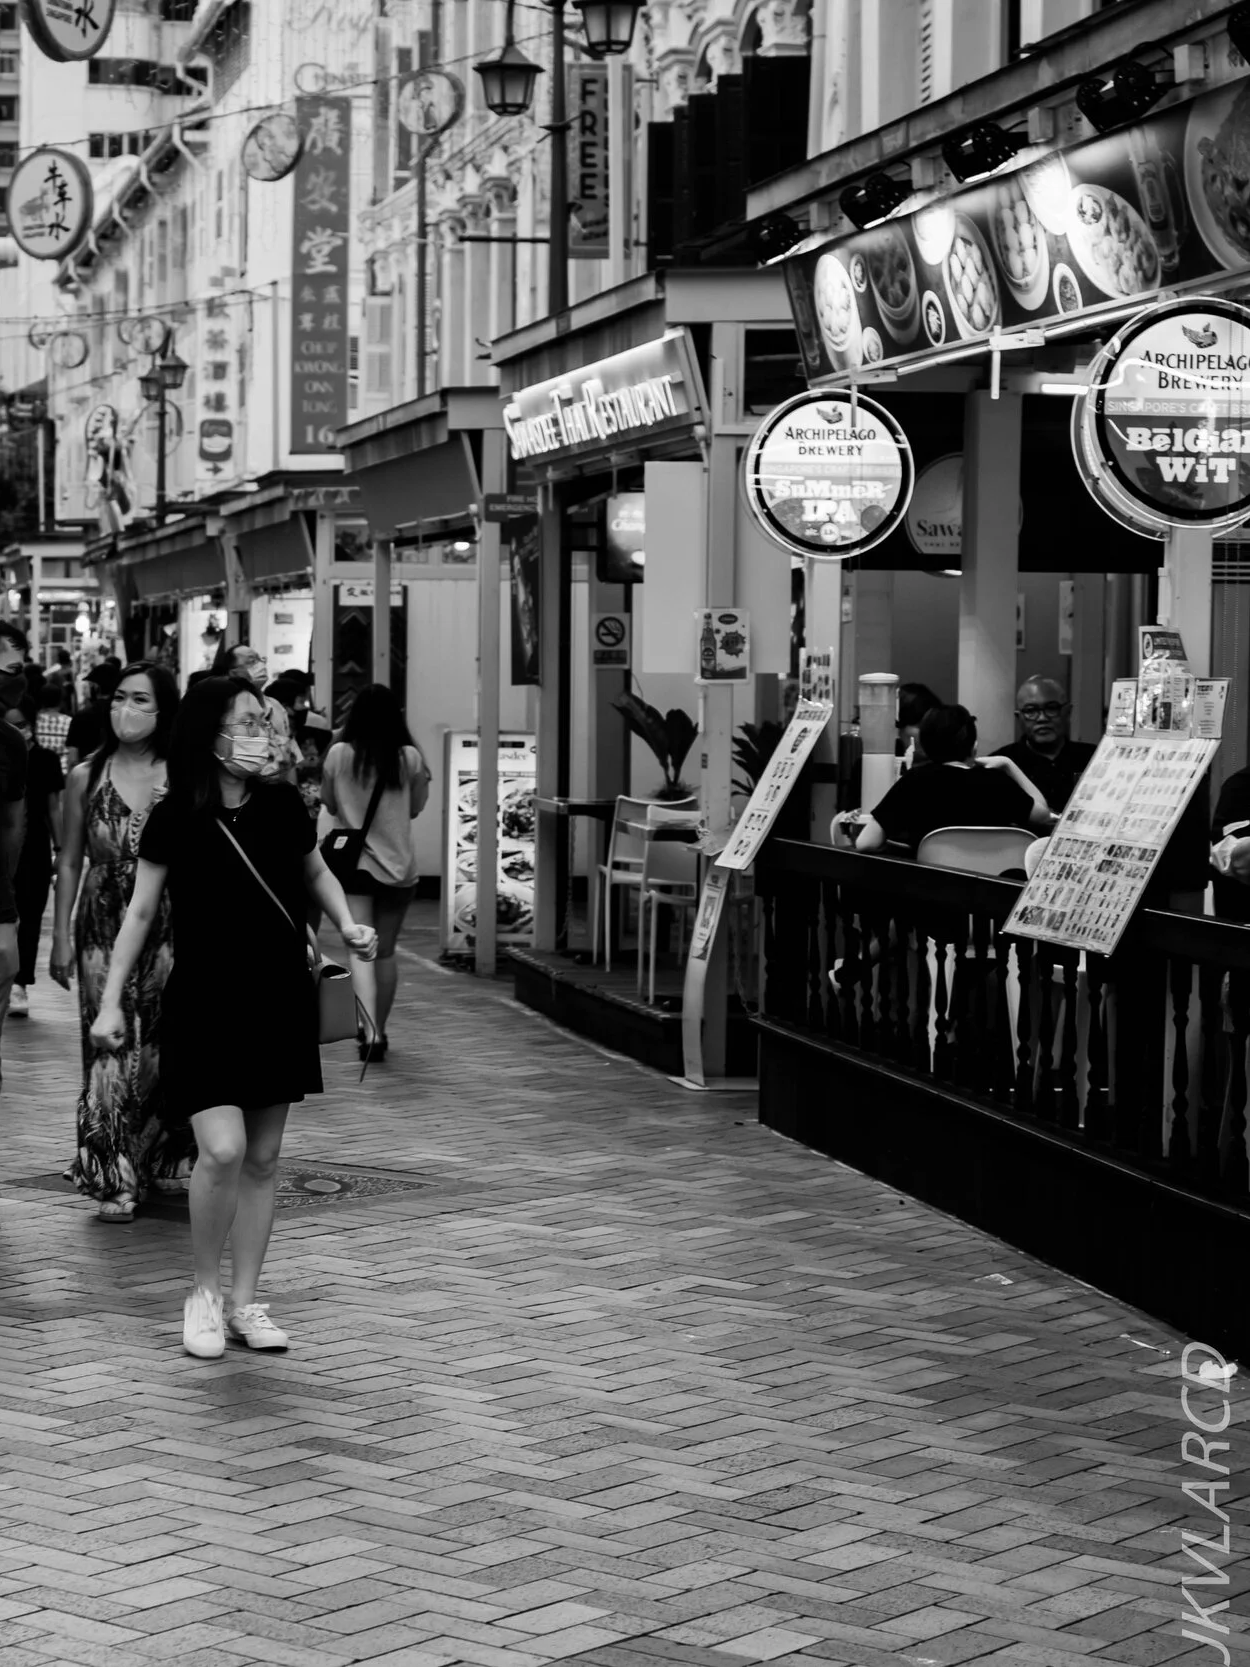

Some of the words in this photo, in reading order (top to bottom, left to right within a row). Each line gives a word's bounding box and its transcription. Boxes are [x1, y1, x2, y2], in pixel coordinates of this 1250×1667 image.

[580, 79, 599, 200] FREE
[293, 360, 345, 373] KWONG
[1138, 350, 1250, 371] ARCHIPELAG
[582, 376, 678, 440] RESTAURANT
[305, 424, 335, 444] 16
[784, 427, 876, 441] ARCHIPELAGO
[798, 443, 864, 456] BREWERY
[801, 500, 857, 523] IPA
